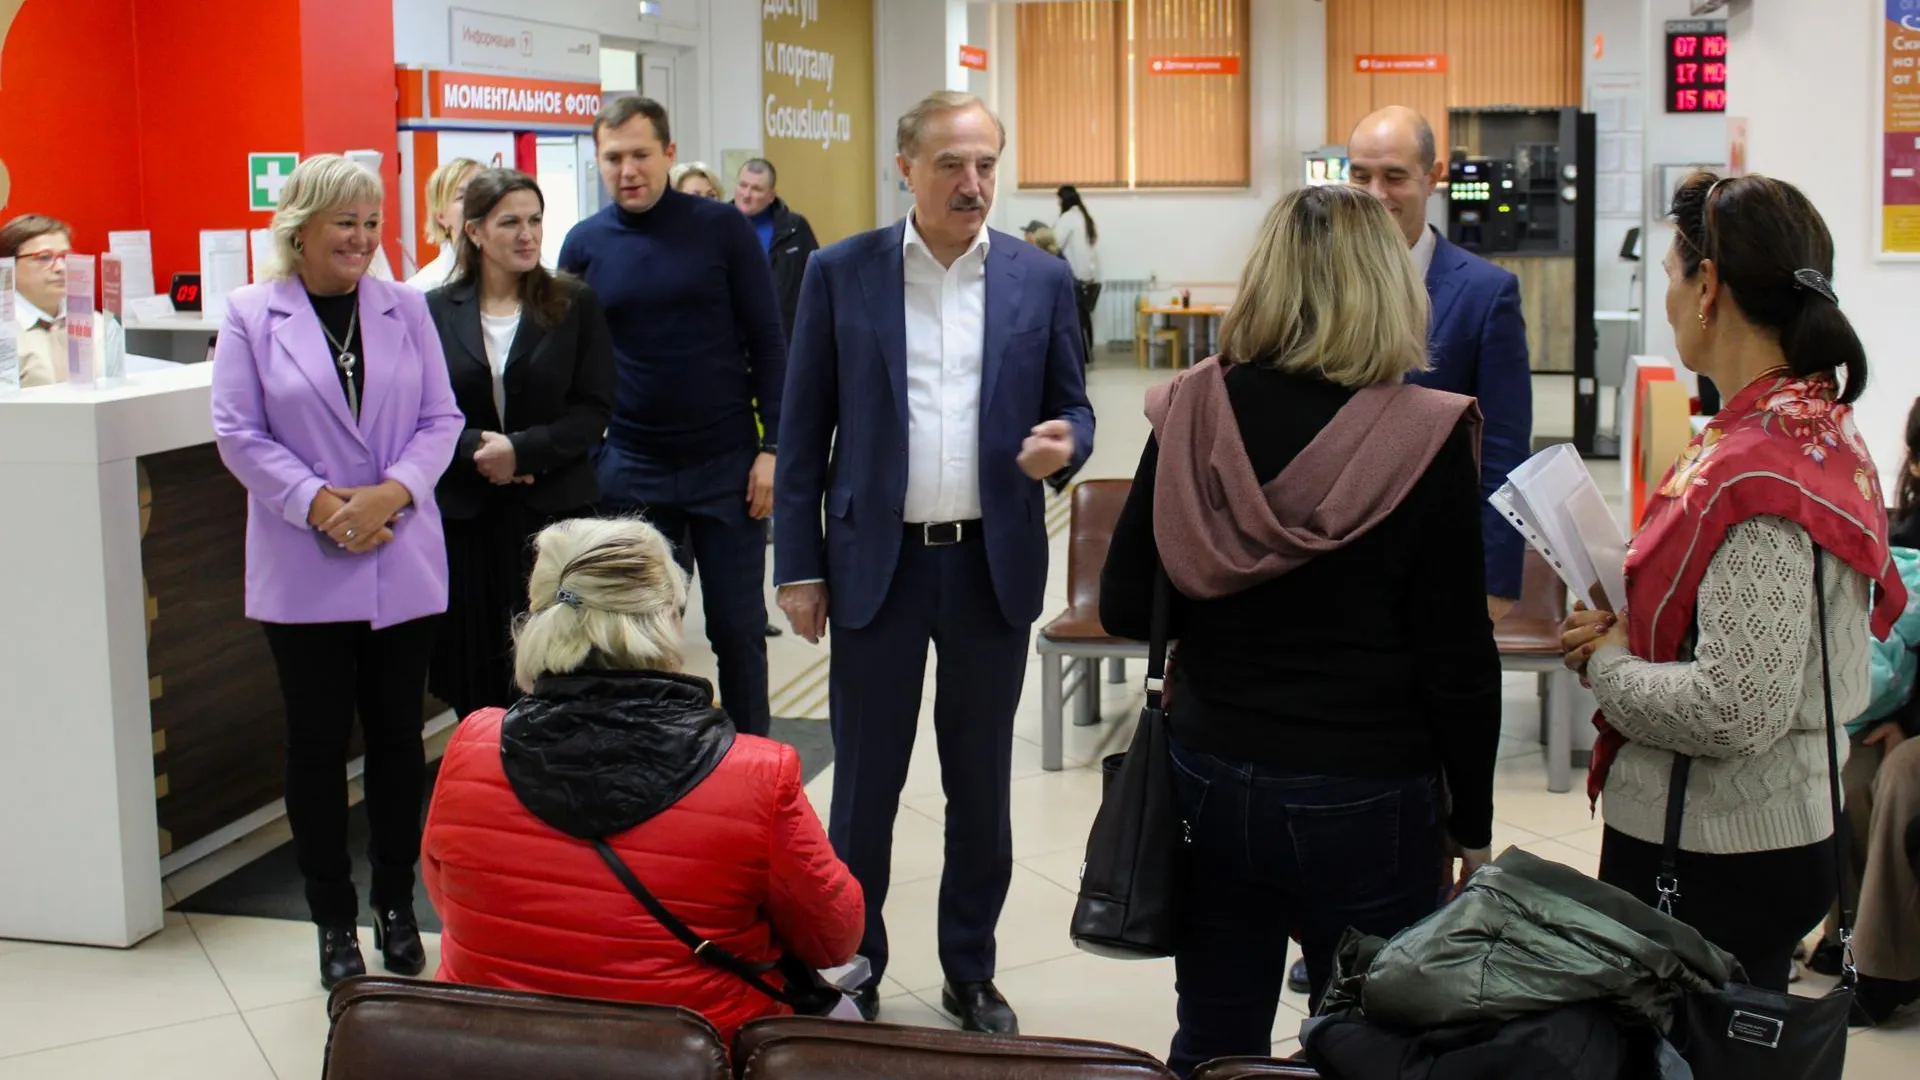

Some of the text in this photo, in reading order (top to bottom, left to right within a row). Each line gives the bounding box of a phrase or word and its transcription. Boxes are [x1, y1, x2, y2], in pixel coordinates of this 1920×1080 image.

[462, 25, 516, 48] Информация
[1673, 36, 1698, 57] 07
[777, 42, 835, 93] порталу
[1675, 63, 1698, 83] 17
[444, 84, 600, 116] МОМЕНТАЛЬНОЕ ФОТО
[1675, 90, 1698, 110] 15
[765, 93, 850, 151] Gosuslugi.ru
[176, 285, 199, 302] 09
